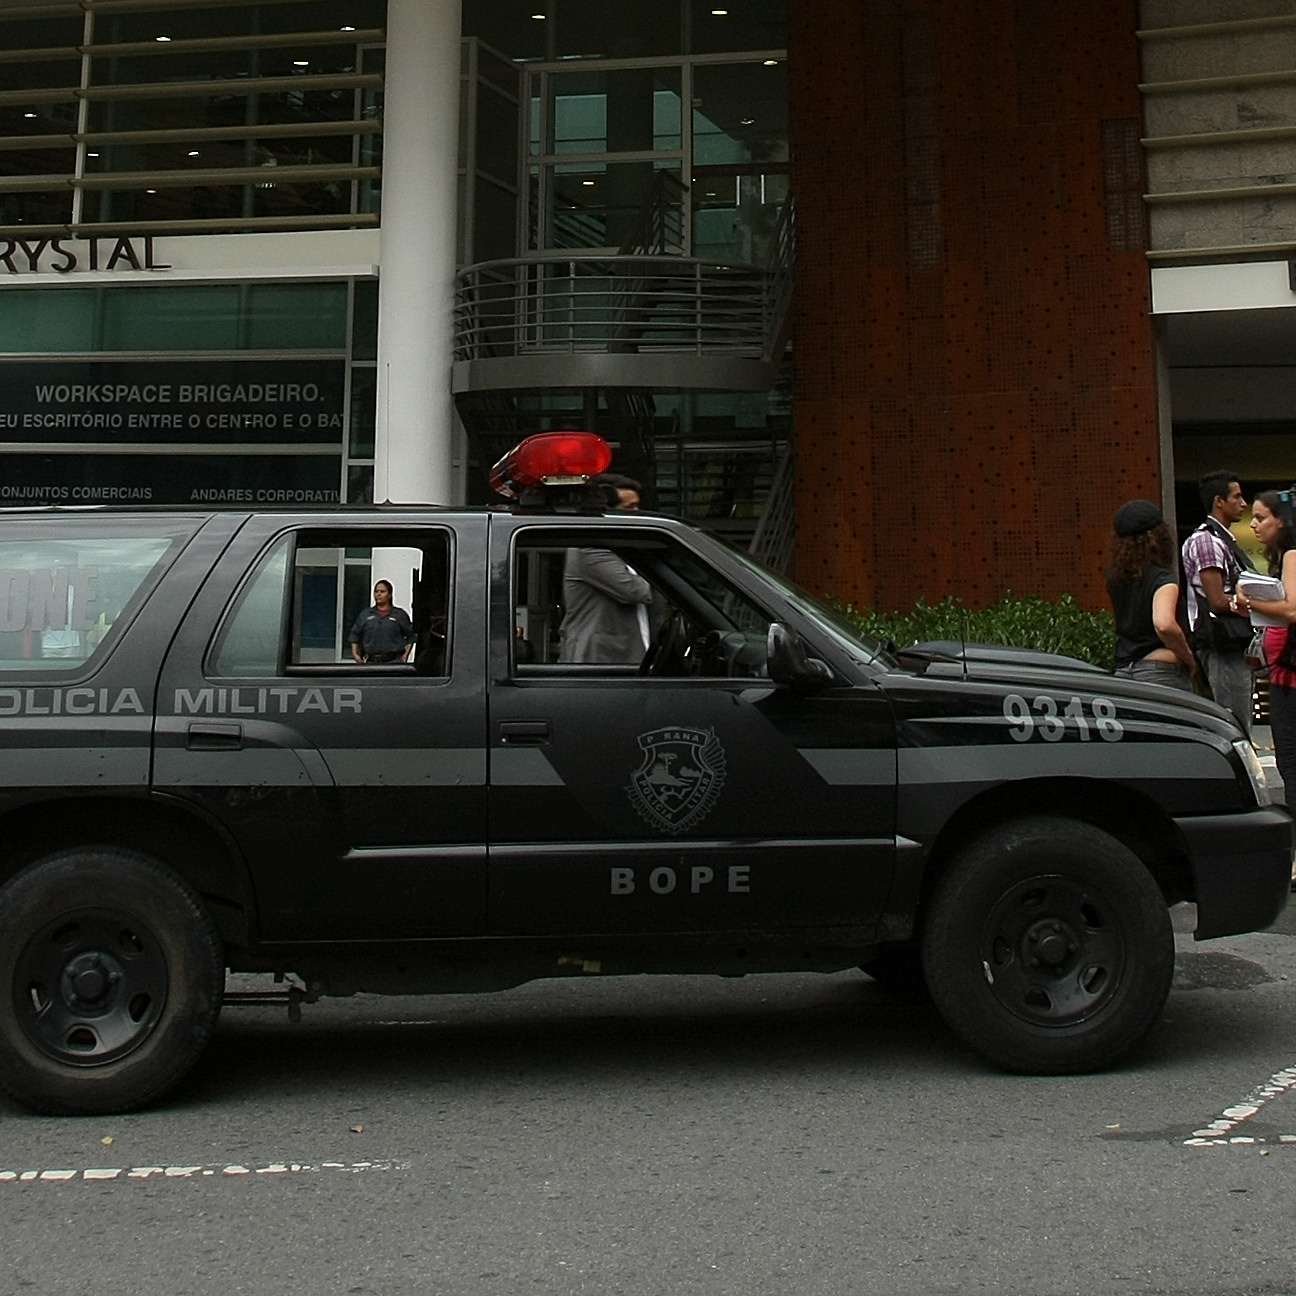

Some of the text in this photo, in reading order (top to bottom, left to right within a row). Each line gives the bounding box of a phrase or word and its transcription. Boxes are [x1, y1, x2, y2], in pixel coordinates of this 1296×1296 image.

[35, 384, 325, 403] WORKSPACE BRIGADEIRO.
[22, 410, 123, 429] ESCRITÓRIO
[127, 414, 183, 428] ENTRE
[188, 414, 201, 428] O
[206, 414, 277, 428] CENTRO
[283, 414, 293, 428] E
[299, 413, 312, 428] O
[72, 487, 153, 499] COMERCIAIS
[190, 488, 253, 501] ANDARES
[174, 687, 362, 714] MILITAR
[1003, 694, 1124, 742] 9318
[610, 865, 751, 895] BOPE
